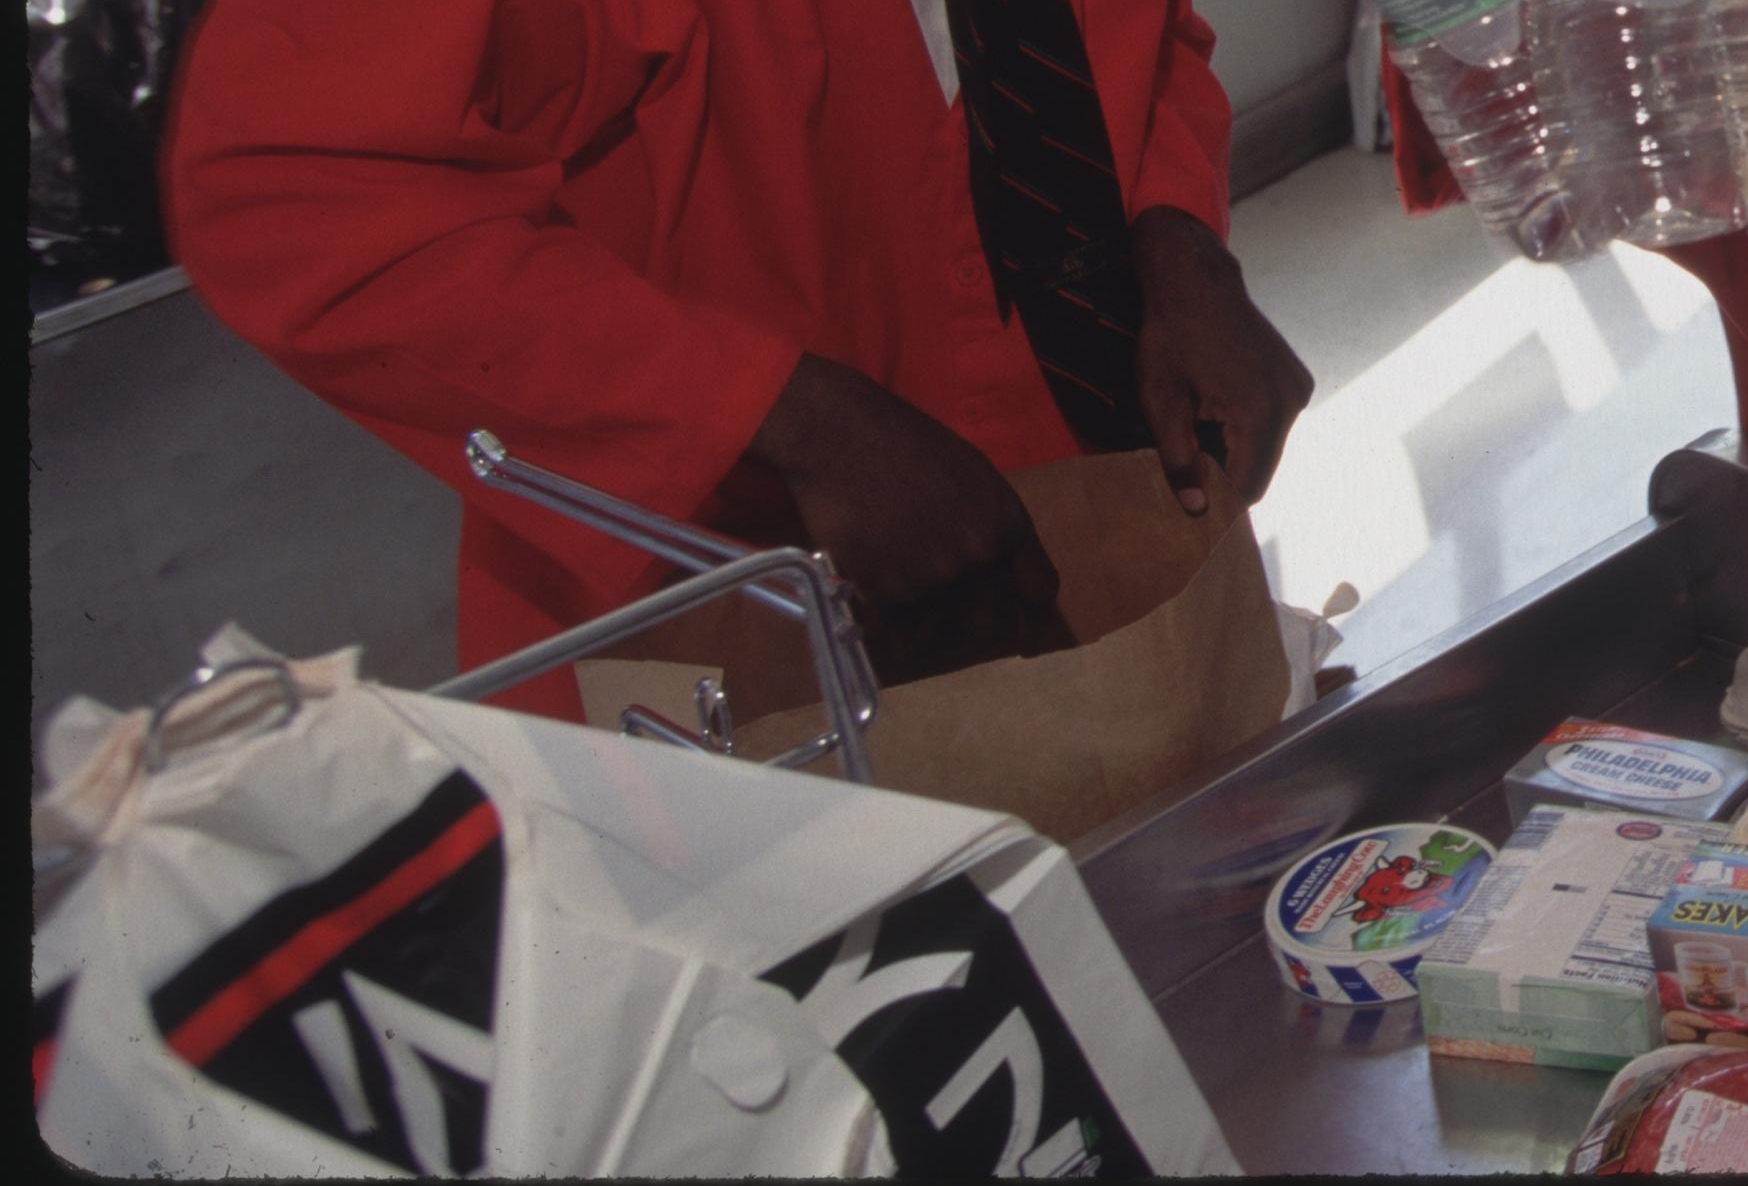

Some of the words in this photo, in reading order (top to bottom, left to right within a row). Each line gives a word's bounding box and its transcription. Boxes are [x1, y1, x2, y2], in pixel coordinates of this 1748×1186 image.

[1564, 743, 1713, 785] PHILADELPHIA
[1570, 761, 1622, 780] CREAM
[1625, 772, 1684, 792] CHEESE
[1287, 896, 1298, 907] 6
[1294, 856, 1333, 900] WEDGES
[1594, 971, 1650, 989] Nutrition
